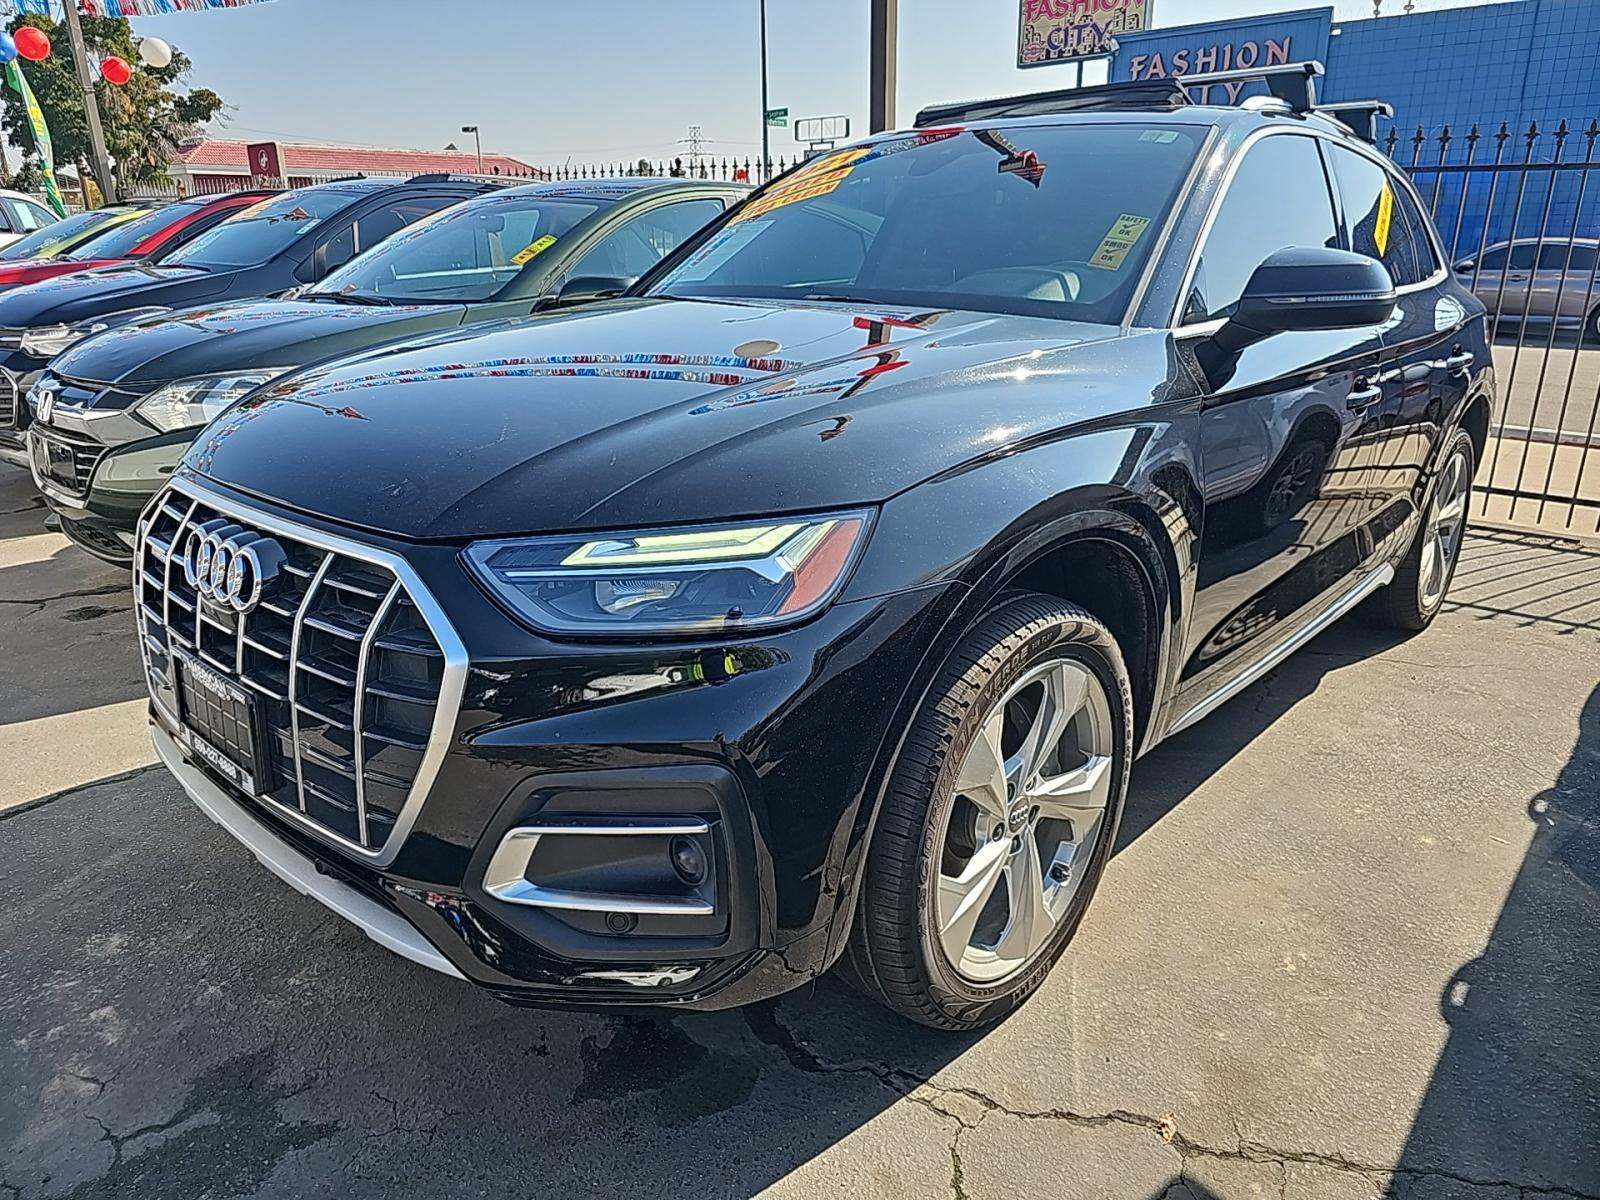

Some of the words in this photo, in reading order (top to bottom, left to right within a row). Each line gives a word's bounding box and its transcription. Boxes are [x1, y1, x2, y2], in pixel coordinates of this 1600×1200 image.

[1046, 20, 1114, 51] CITY
[1130, 36, 1291, 81] FASHION
[1120, 215, 1148, 225] SAFETY
[1100, 254, 1114, 262] OK
